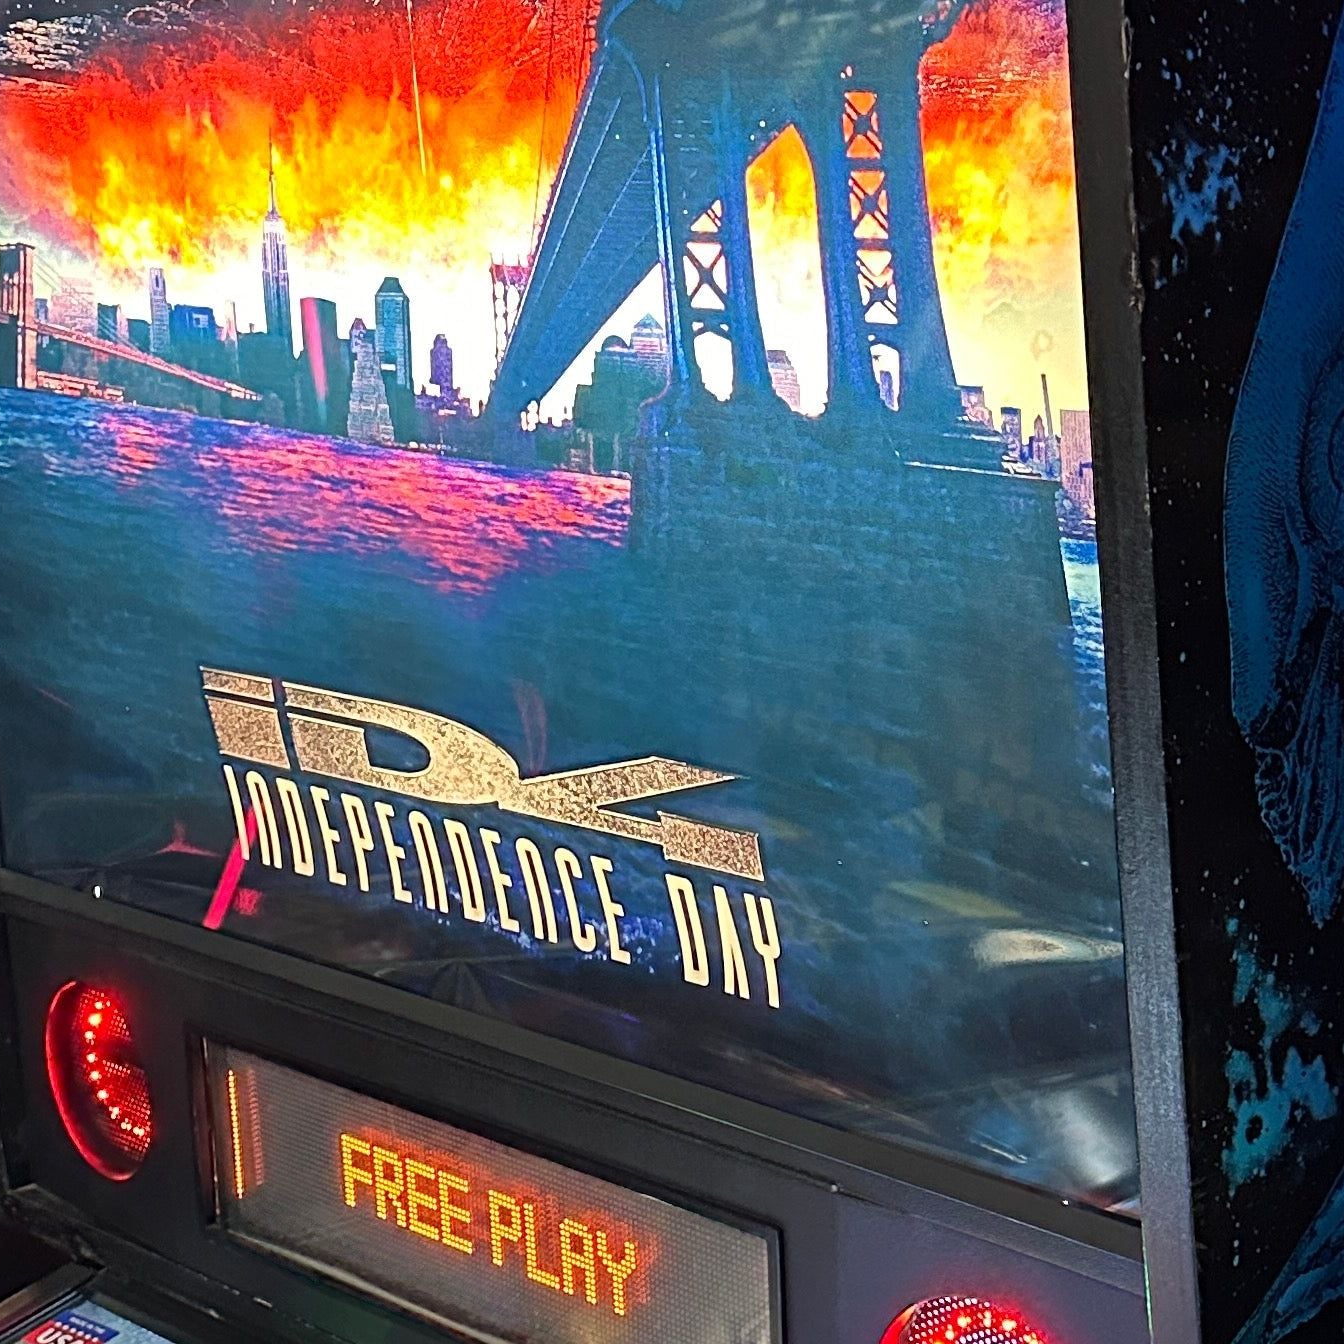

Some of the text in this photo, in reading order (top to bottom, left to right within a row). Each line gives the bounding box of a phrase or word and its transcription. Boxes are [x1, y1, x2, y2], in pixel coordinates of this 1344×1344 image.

[222, 763, 781, 1009] INDEPENDENCE DAY
[339, 1131, 638, 1317] FREE PLAY
